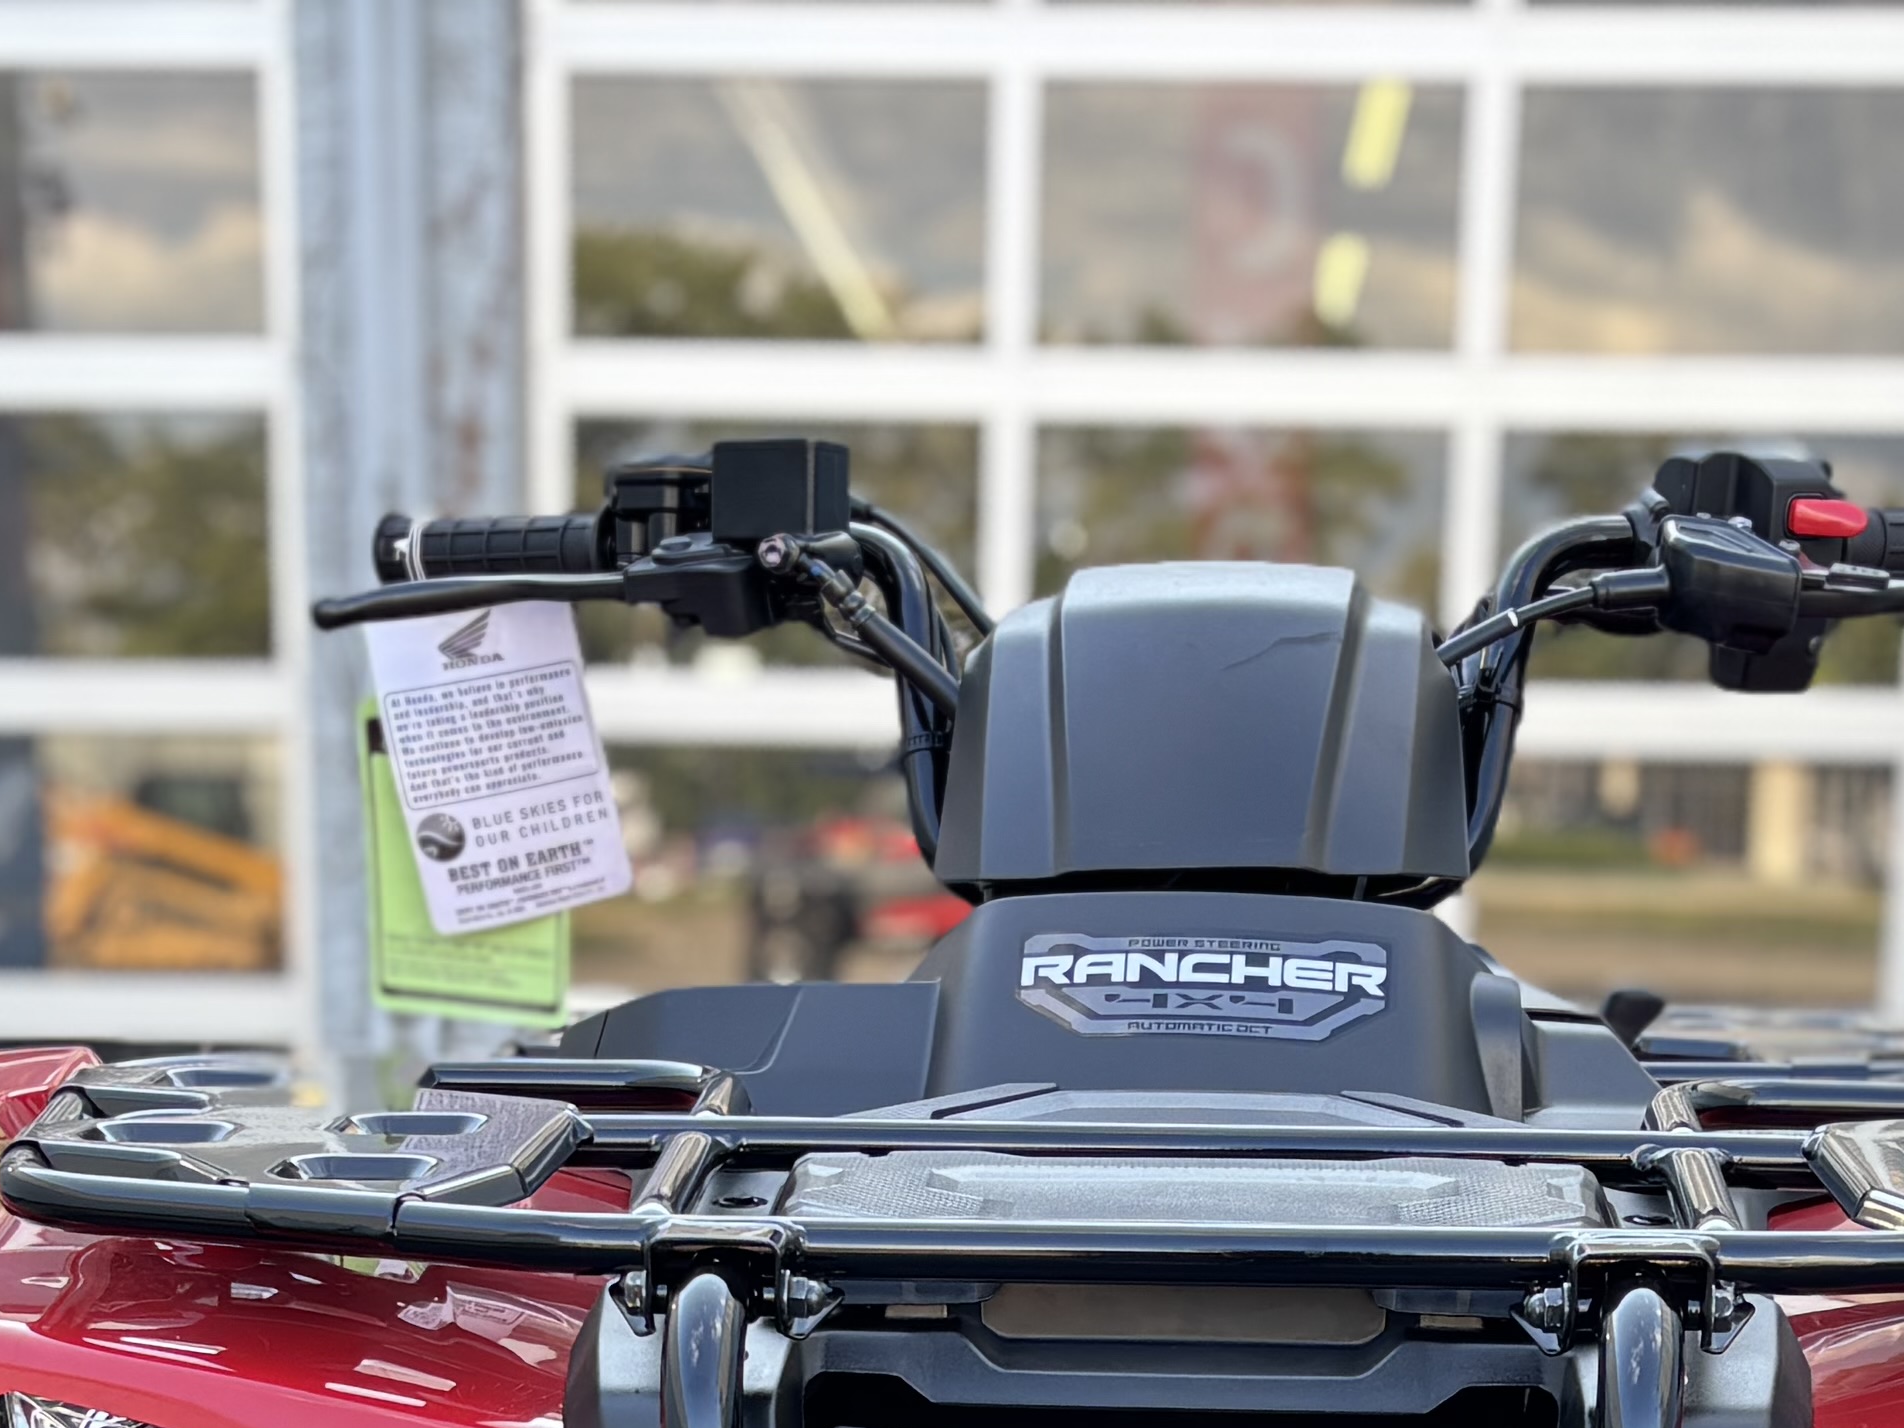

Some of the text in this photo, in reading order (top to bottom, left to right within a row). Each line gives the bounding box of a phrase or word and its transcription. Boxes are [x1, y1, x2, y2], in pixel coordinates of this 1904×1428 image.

[442, 653, 505, 671] HONDA
[457, 683, 492, 697] believe
[509, 668, 571, 689] performance
[426, 716, 457, 728] taking
[469, 703, 521, 719] leadership
[524, 694, 564, 711] position
[472, 696, 489, 706] and
[398, 733, 423, 744] when
[438, 726, 469, 738] comes
[486, 718, 503, 729] the
[419, 739, 461, 753] continue
[479, 729, 516, 743] develop
[404, 750, 466, 768] technologies
[469, 746, 484, 757] for
[507, 735, 544, 750] current
[548, 730, 565, 741] and
[441, 755, 500, 775] powersports
[464, 771, 480, 783] the
[483, 766, 505, 778] kind
[521, 751, 584, 771] performance
[413, 787, 461, 804] everybody
[465, 784, 482, 795] can
[472, 790, 604, 830] BLUE SKIES FOR
[475, 807, 609, 848] OUR CHILDREN
[447, 861, 492, 883] BEST
[497, 855, 520, 873] ON
[456, 869, 542, 896] PERFORMANCE
[1128, 938, 1281, 952] POWER STEERING
[1020, 952, 1387, 997] RANCHER
[1127, 1021, 1233, 1034] AUTOMATIC
